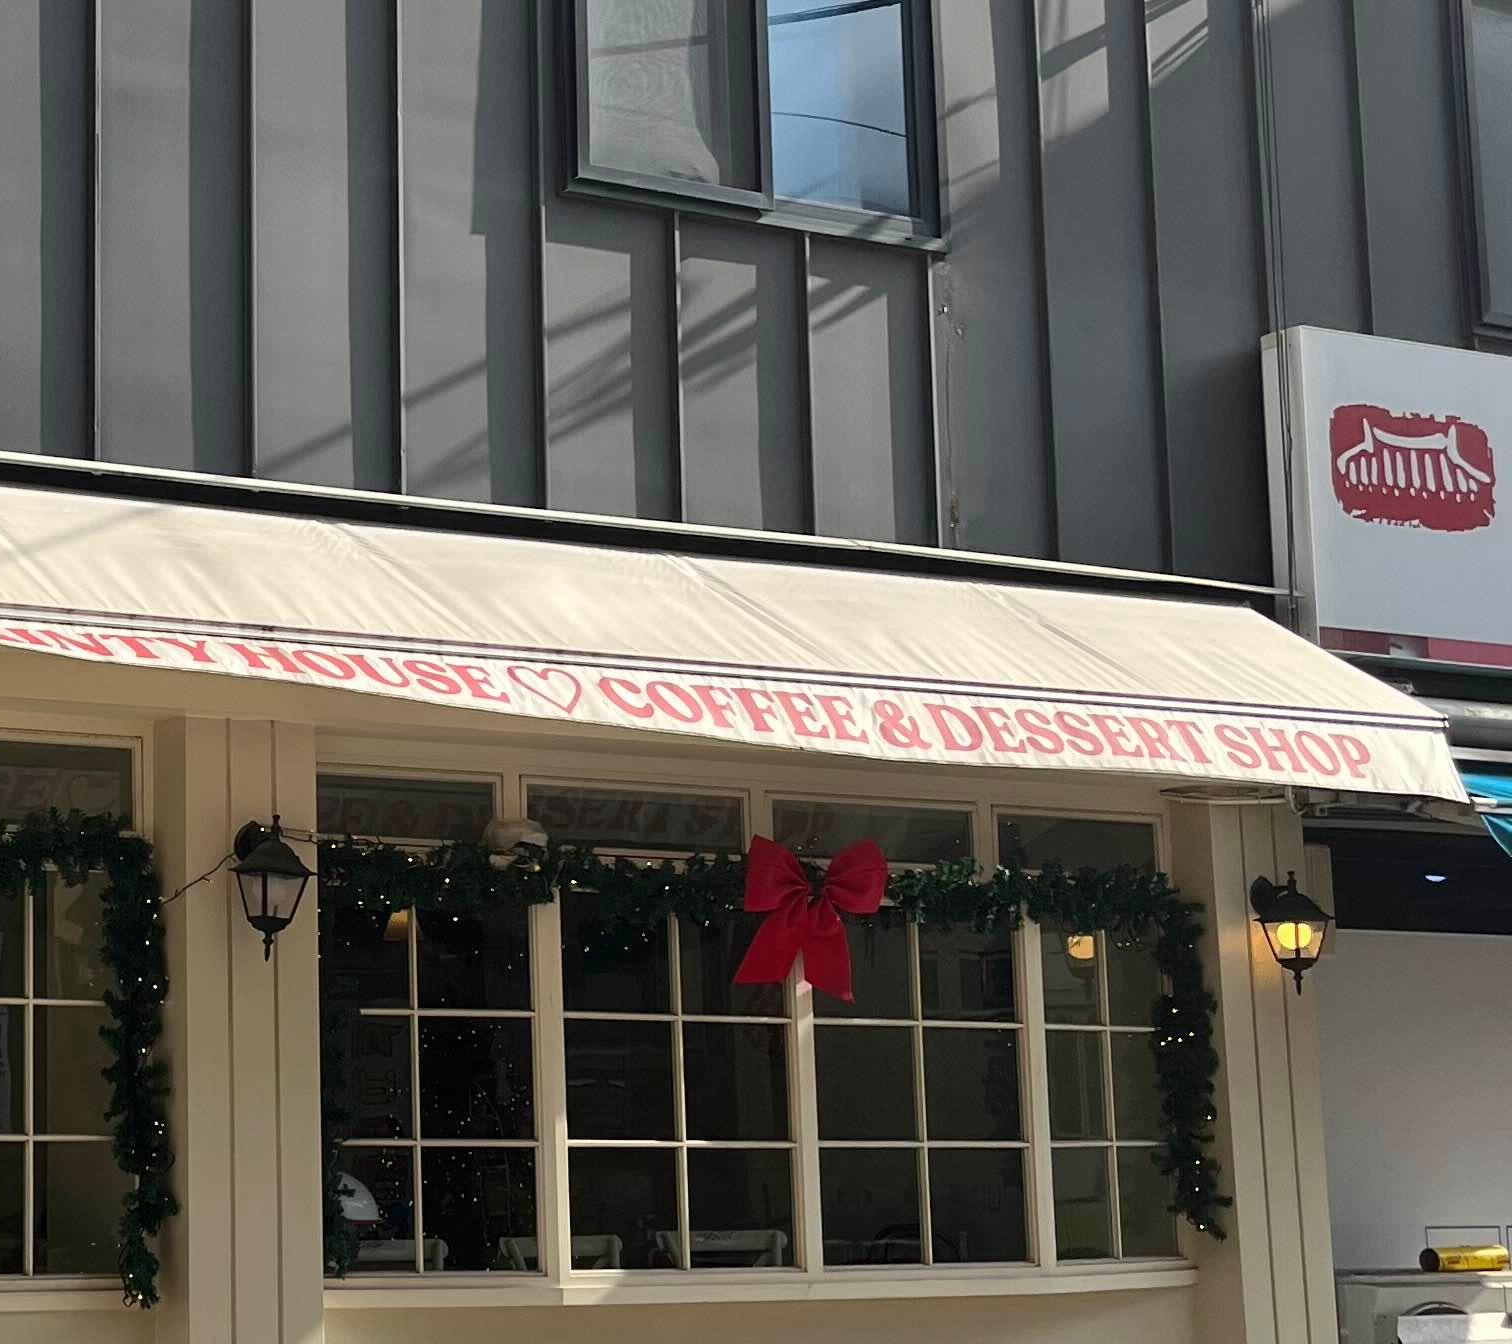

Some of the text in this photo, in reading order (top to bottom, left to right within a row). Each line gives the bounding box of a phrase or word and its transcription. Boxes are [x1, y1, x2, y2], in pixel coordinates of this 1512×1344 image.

[226, 640, 512, 705] HOUSE
[597, 674, 872, 744] COFFEE
[874, 699, 931, 750] &
[924, 702, 1212, 765] DESSERT
[1215, 723, 1372, 778] SHOP
